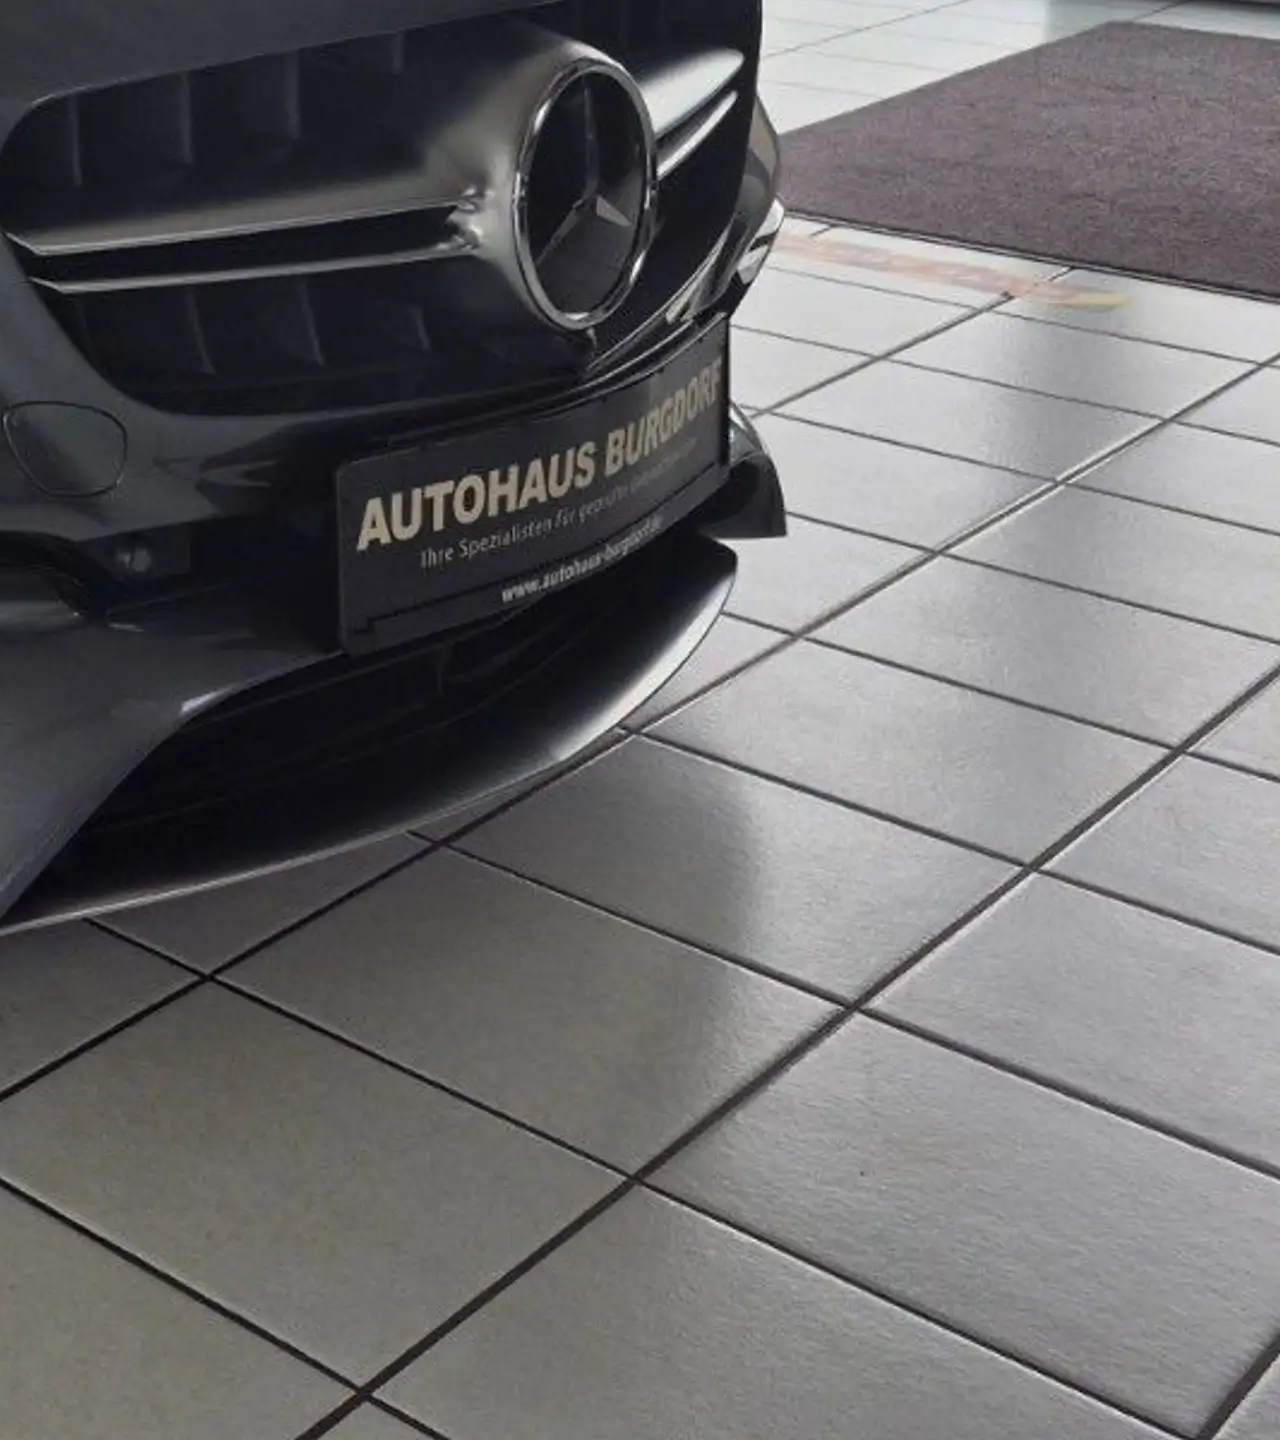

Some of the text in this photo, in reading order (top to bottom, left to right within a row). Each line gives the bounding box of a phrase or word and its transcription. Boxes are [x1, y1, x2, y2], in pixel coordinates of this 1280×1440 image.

[355, 440, 596, 551] AUTOHAUS
[604, 355, 723, 480] BURGDORF
[420, 544, 455, 569] Ihre
[458, 517, 552, 559] Spezialisten
